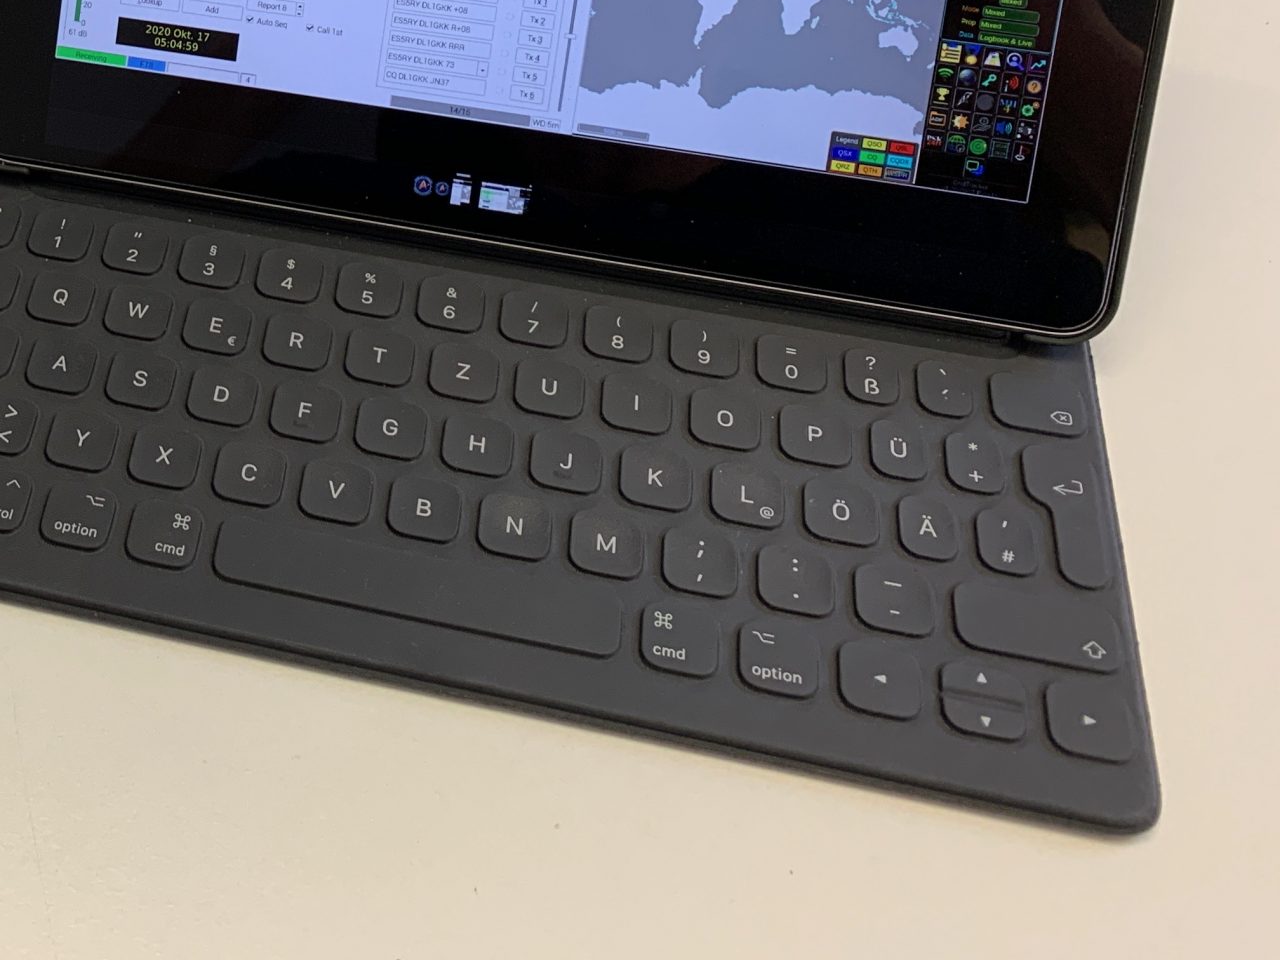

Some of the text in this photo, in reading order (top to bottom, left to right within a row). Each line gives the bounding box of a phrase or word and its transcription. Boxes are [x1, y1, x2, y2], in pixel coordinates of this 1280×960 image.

[145, 24, 171, 36] 2020
[197, 31, 210, 42] 17
[154, 37, 199, 52] 05:04:59
[53, 288, 69, 306] Q
[128, 301, 150, 319] W
[209, 317, 224, 334] E
[289, 331, 304, 349] R
[52, 355, 67, 372] A
[373, 346, 388, 364] T
[132, 370, 148, 387] S
[455, 362, 471, 380] Z
[213, 385, 230, 403] D
[541, 378, 558, 396] U
[298, 401, 313, 418] F
[717, 410, 734, 427] O
[382, 418, 399, 436] G
[808, 425, 823, 442] P
[76, 428, 91, 447] Y
[468, 434, 486, 454] H
[155, 445, 174, 465] X
[890, 437, 907, 458] Ü
[559, 453, 573, 470] J
[241, 463, 258, 482] C
[647, 468, 663, 487] K
[328, 480, 346, 499] V
[740, 485, 754, 504] L
[416, 498, 432, 517] B
[832, 499, 850, 521] Ö
[54, 521, 98, 538] option
[506, 515, 523, 536] N
[919, 514, 938, 538] Ä
[154, 542, 185, 557] cmd
[596, 533, 617, 554] M
[652, 645, 686, 660] cmd
[751, 665, 803, 685] option
